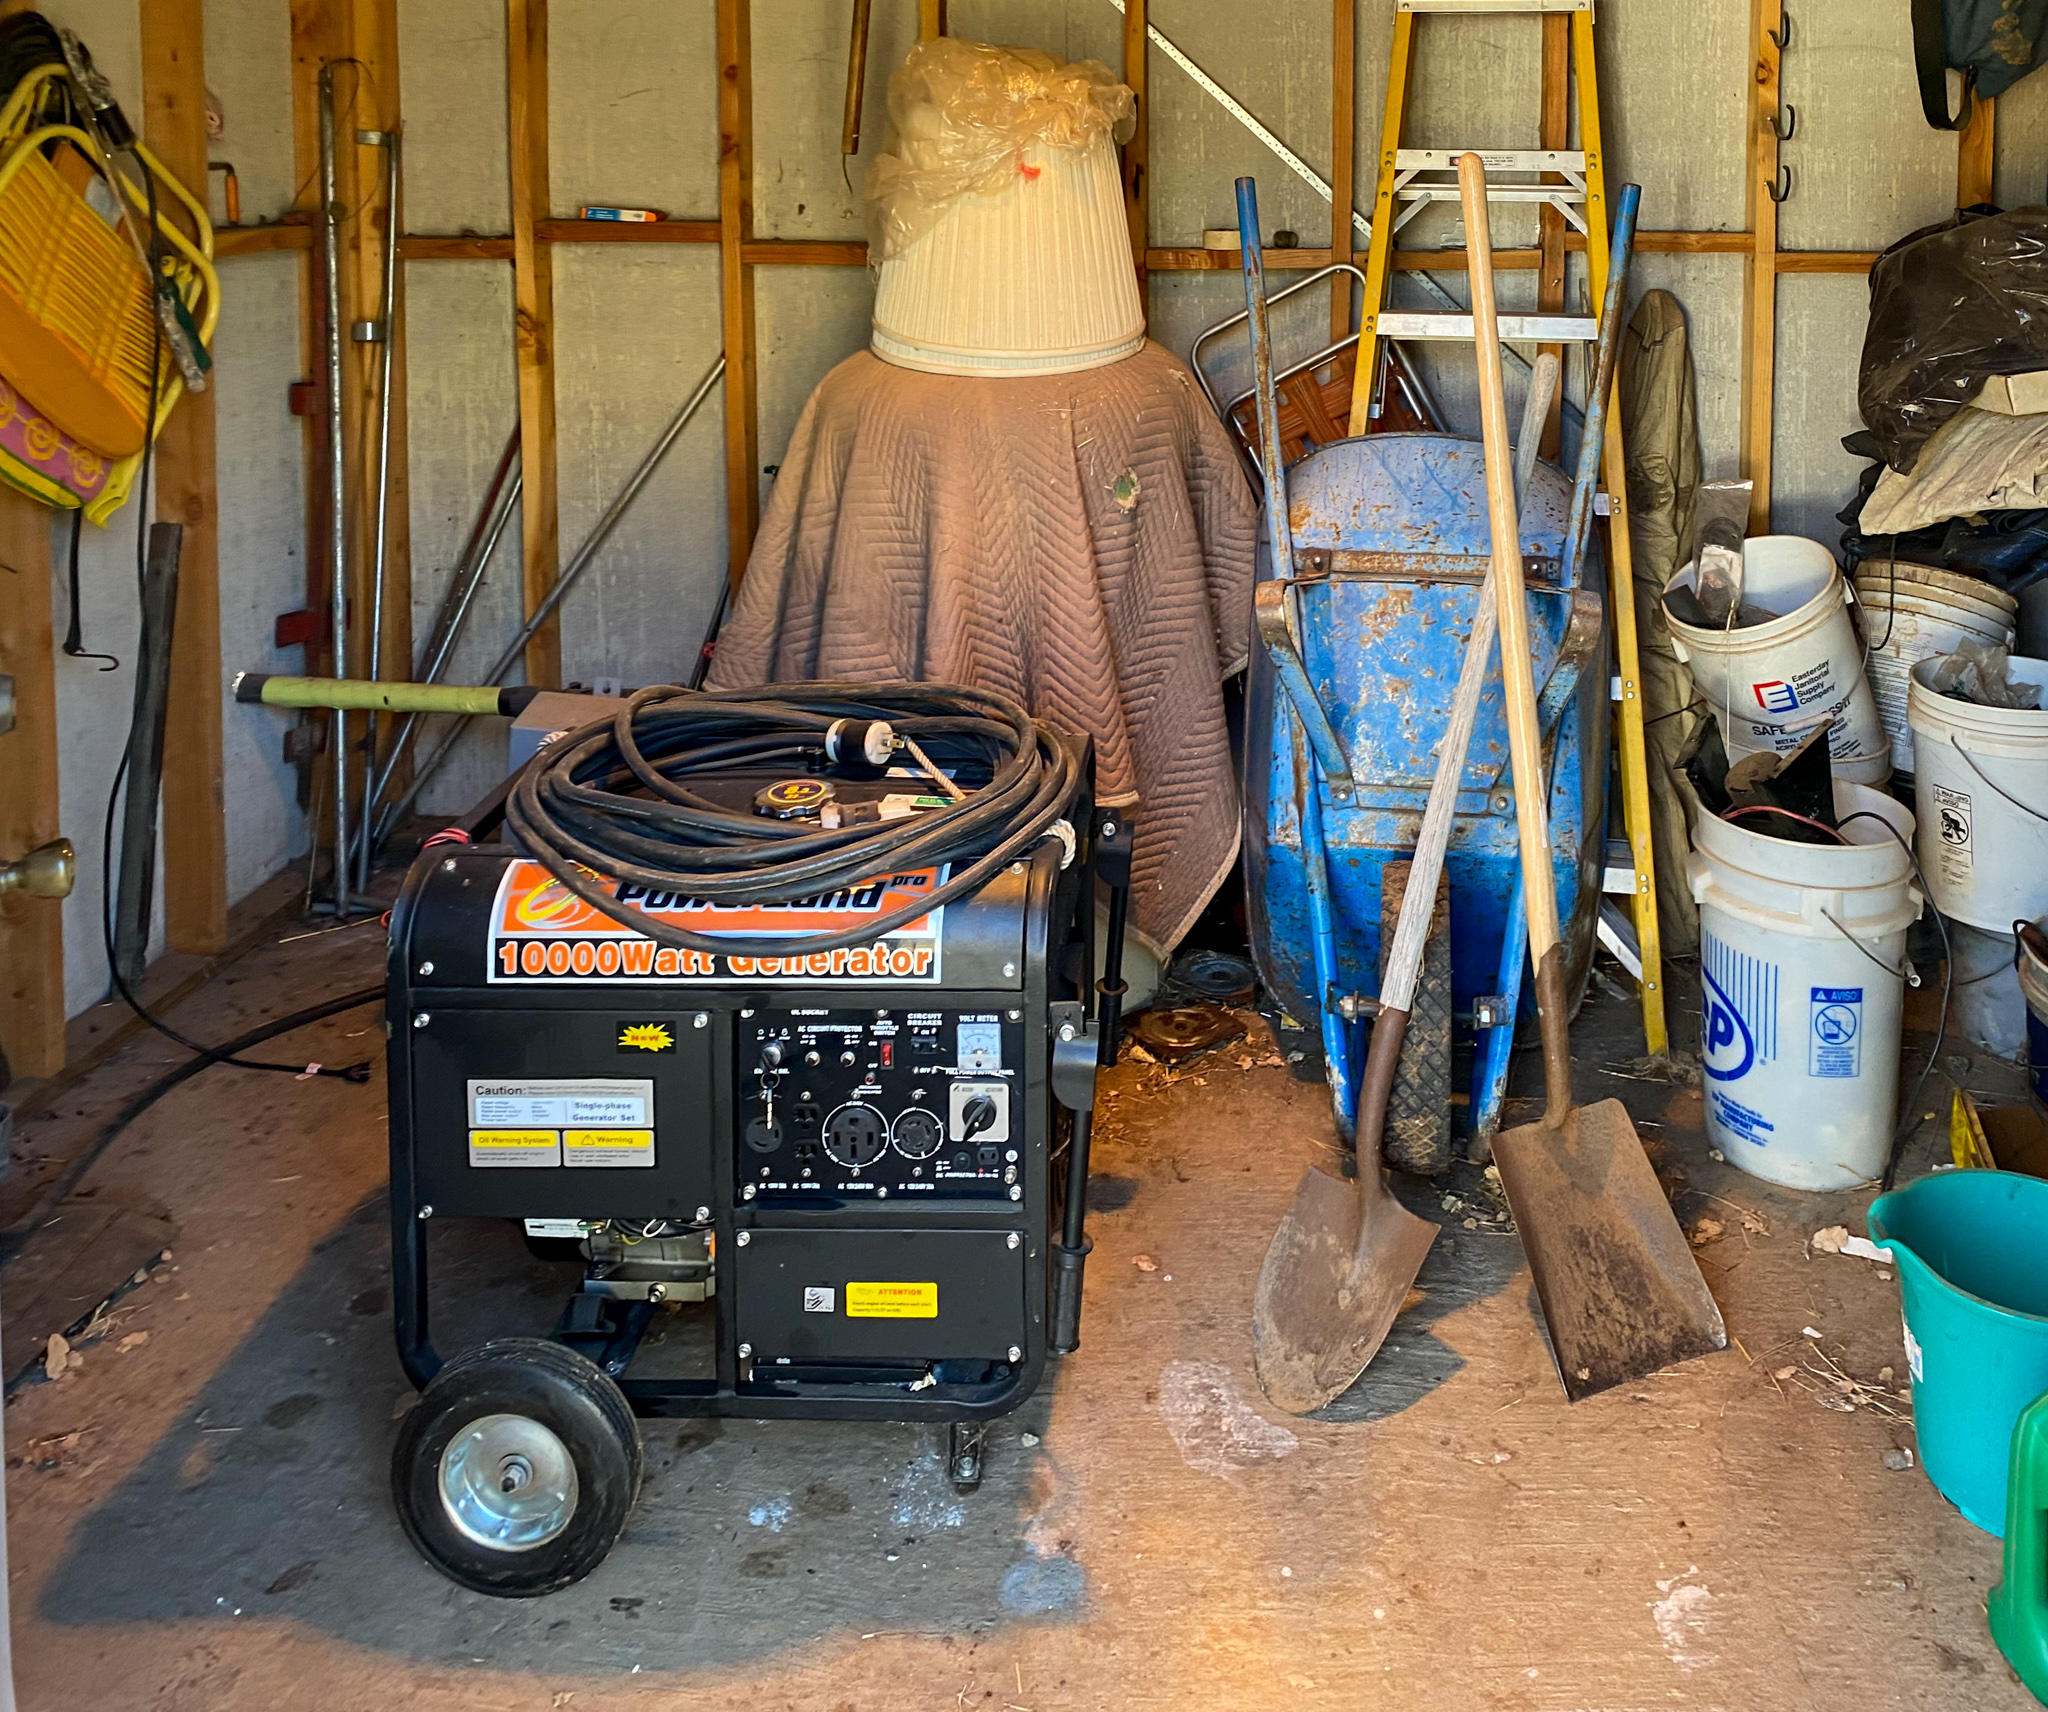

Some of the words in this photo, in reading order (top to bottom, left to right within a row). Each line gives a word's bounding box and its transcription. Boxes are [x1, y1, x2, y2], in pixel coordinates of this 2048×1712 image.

[1792, 659, 1829, 682] Easterday
[1795, 668, 1830, 690] Janitorial
[1797, 681, 1824, 698] Supply
[1800, 682, 1835, 705] Company
[890, 874, 928, 890] pro
[499, 941, 713, 976] 10000Watt
[976, 1015, 999, 1023] METER
[475, 1085, 527, 1096] Caution:
[574, 1102, 632, 1111] Single-phase
[572, 1114, 617, 1122] Generator
[621, 1114, 636, 1122] Set
[490, 1136, 521, 1145] Warning
[522, 1136, 550, 1145] System
[596, 1136, 633, 1145] Warning
[878, 1288, 923, 1296] ATTENTION
